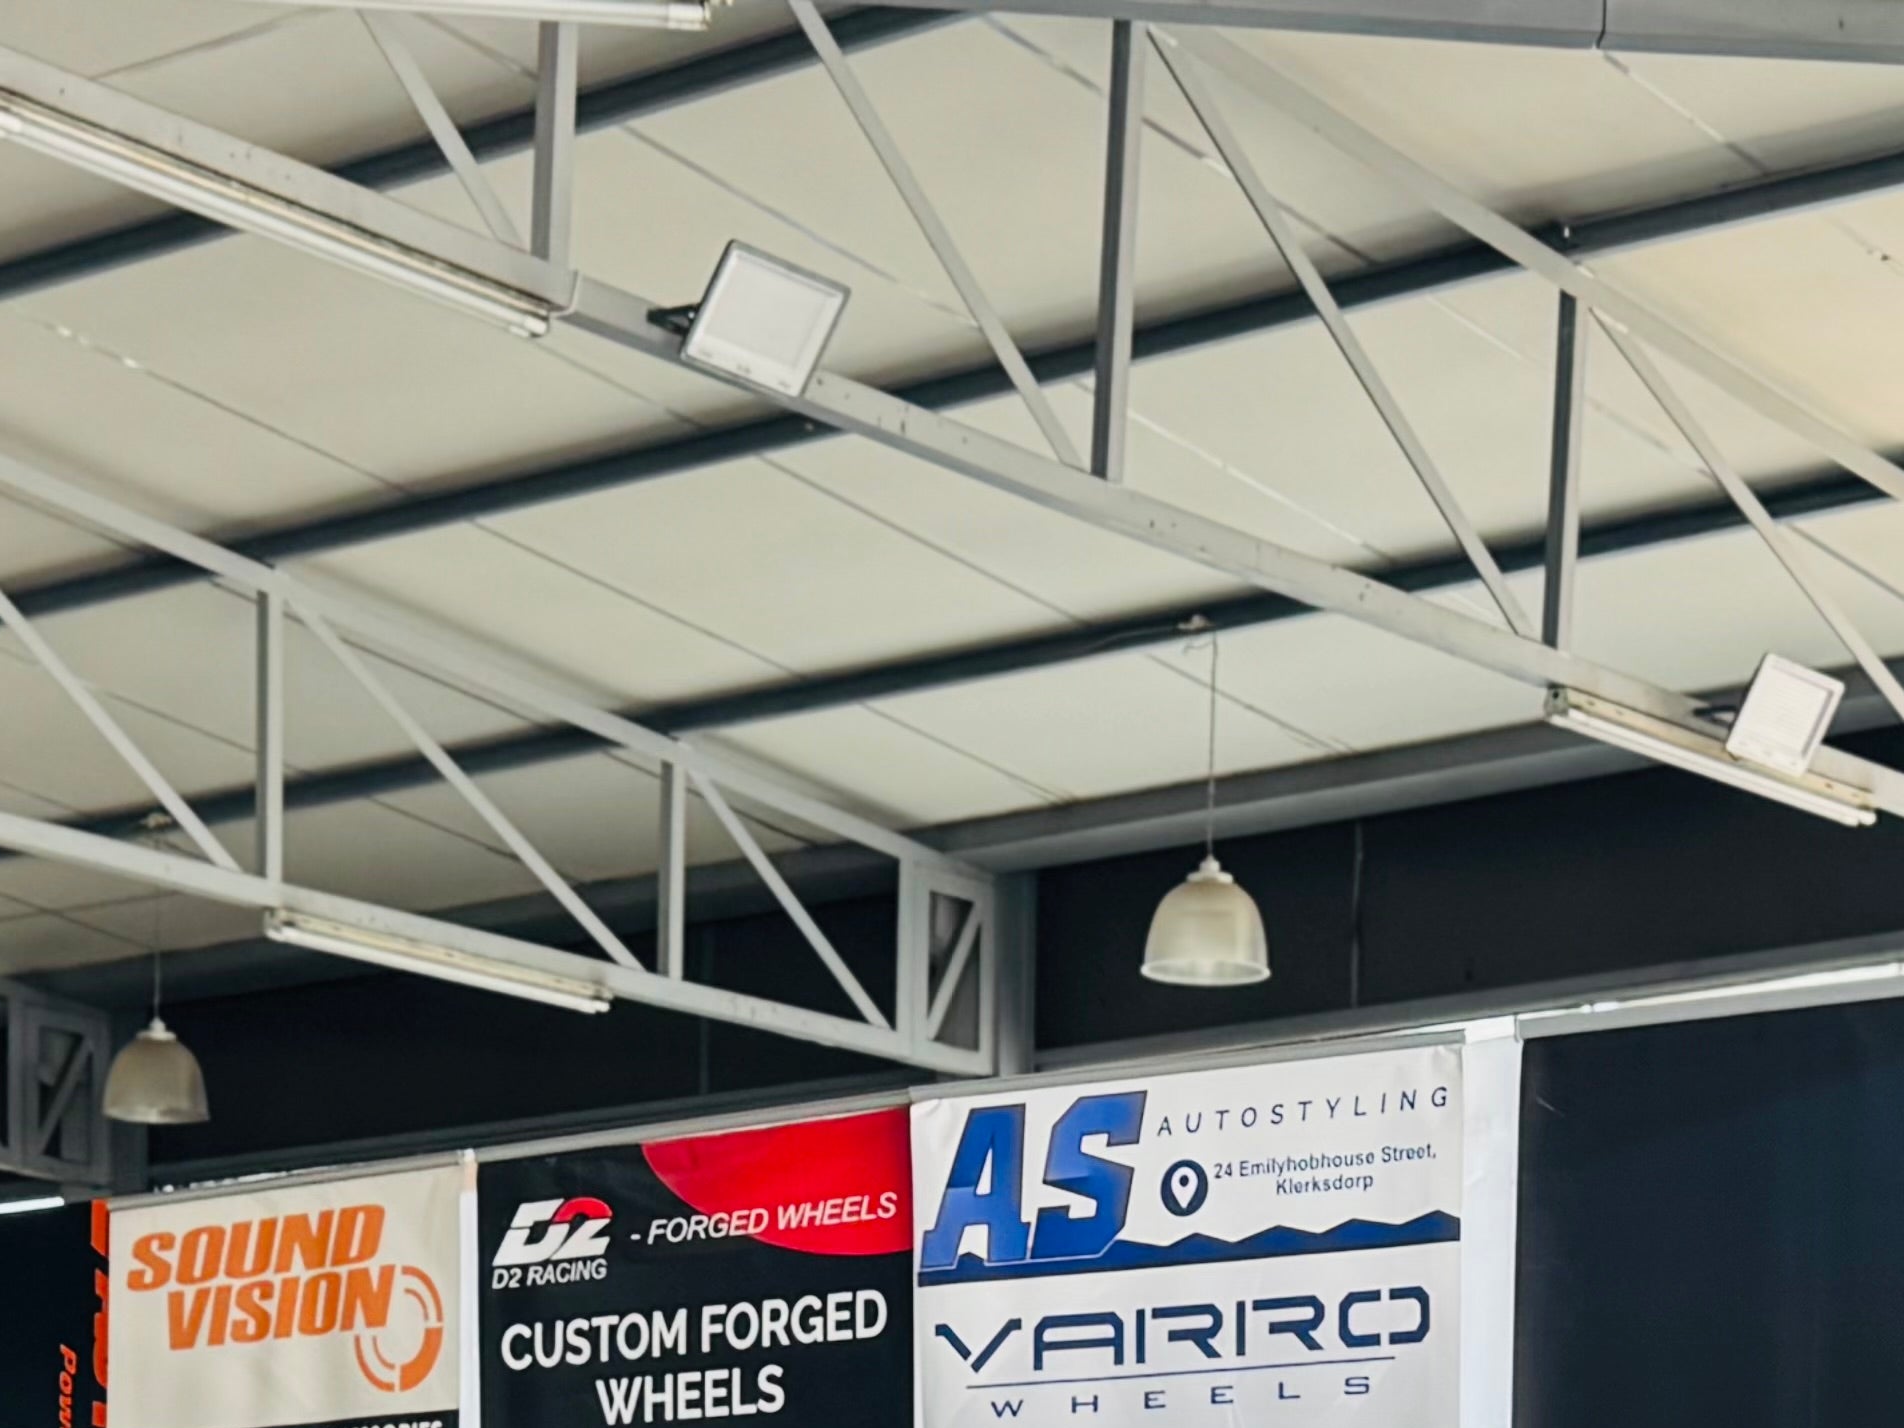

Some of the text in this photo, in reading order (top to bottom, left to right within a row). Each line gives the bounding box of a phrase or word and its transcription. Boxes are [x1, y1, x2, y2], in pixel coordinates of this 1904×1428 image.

[1156, 1086, 1449, 1138] AUTOSTYLING
[917, 1090, 1148, 1270] AS
[1213, 1144, 1437, 1181] 24 Emilyhobhouse Street,
[1276, 1172, 1374, 1196] Klerksdorp
[492, 1197, 613, 1266] D2
[647, 1191, 897, 1245] FORGED WHEELS
[127, 1204, 385, 1294] SOUND
[492, 1259, 608, 1289] D2 RACING
[168, 1264, 395, 1351] VISION
[501, 1289, 888, 1370] CUSTOM FORGED
[595, 1364, 785, 1426] WHEELS
[990, 1376, 1370, 1419] WHEELS
